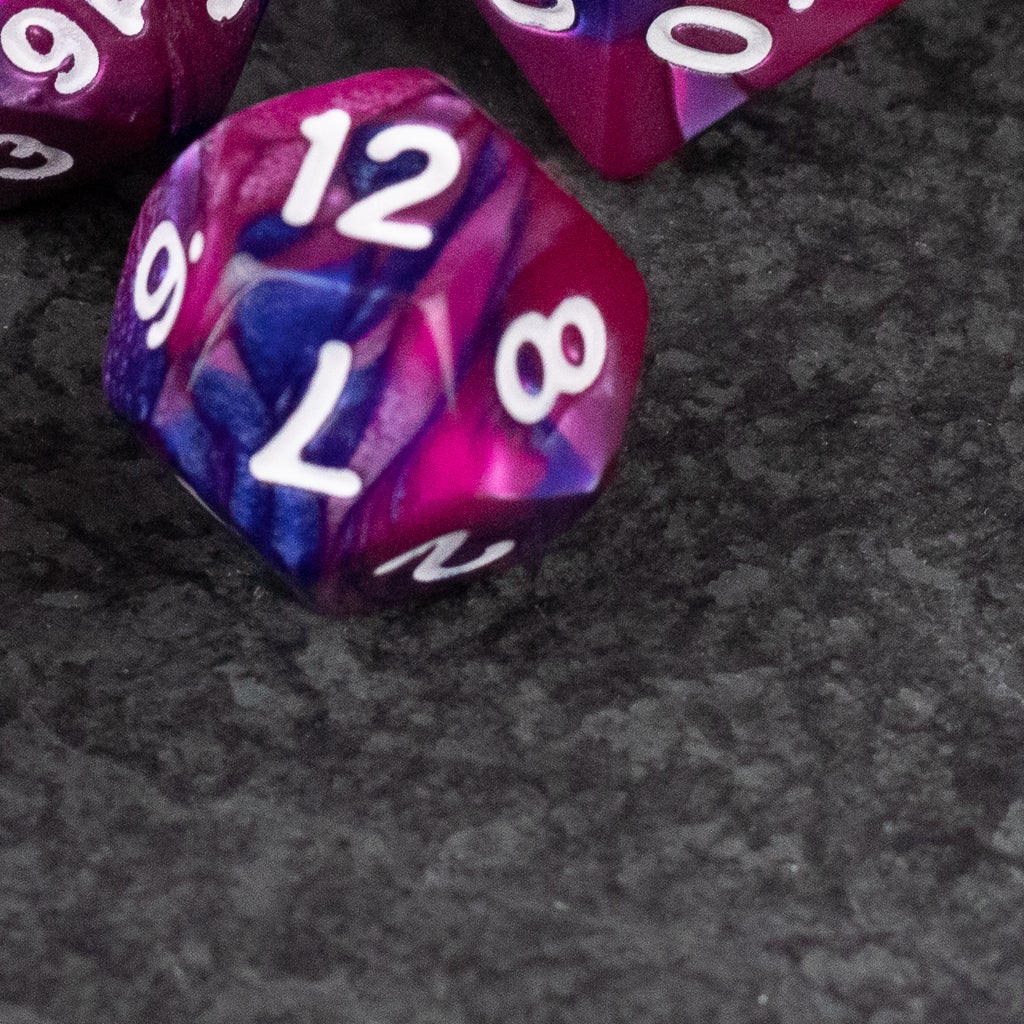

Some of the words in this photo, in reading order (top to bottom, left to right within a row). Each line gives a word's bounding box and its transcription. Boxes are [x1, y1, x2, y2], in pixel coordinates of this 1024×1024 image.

[282, 107, 462, 250] 12
[248, 340, 363, 500] 7
[494, 295, 608, 425] 8
